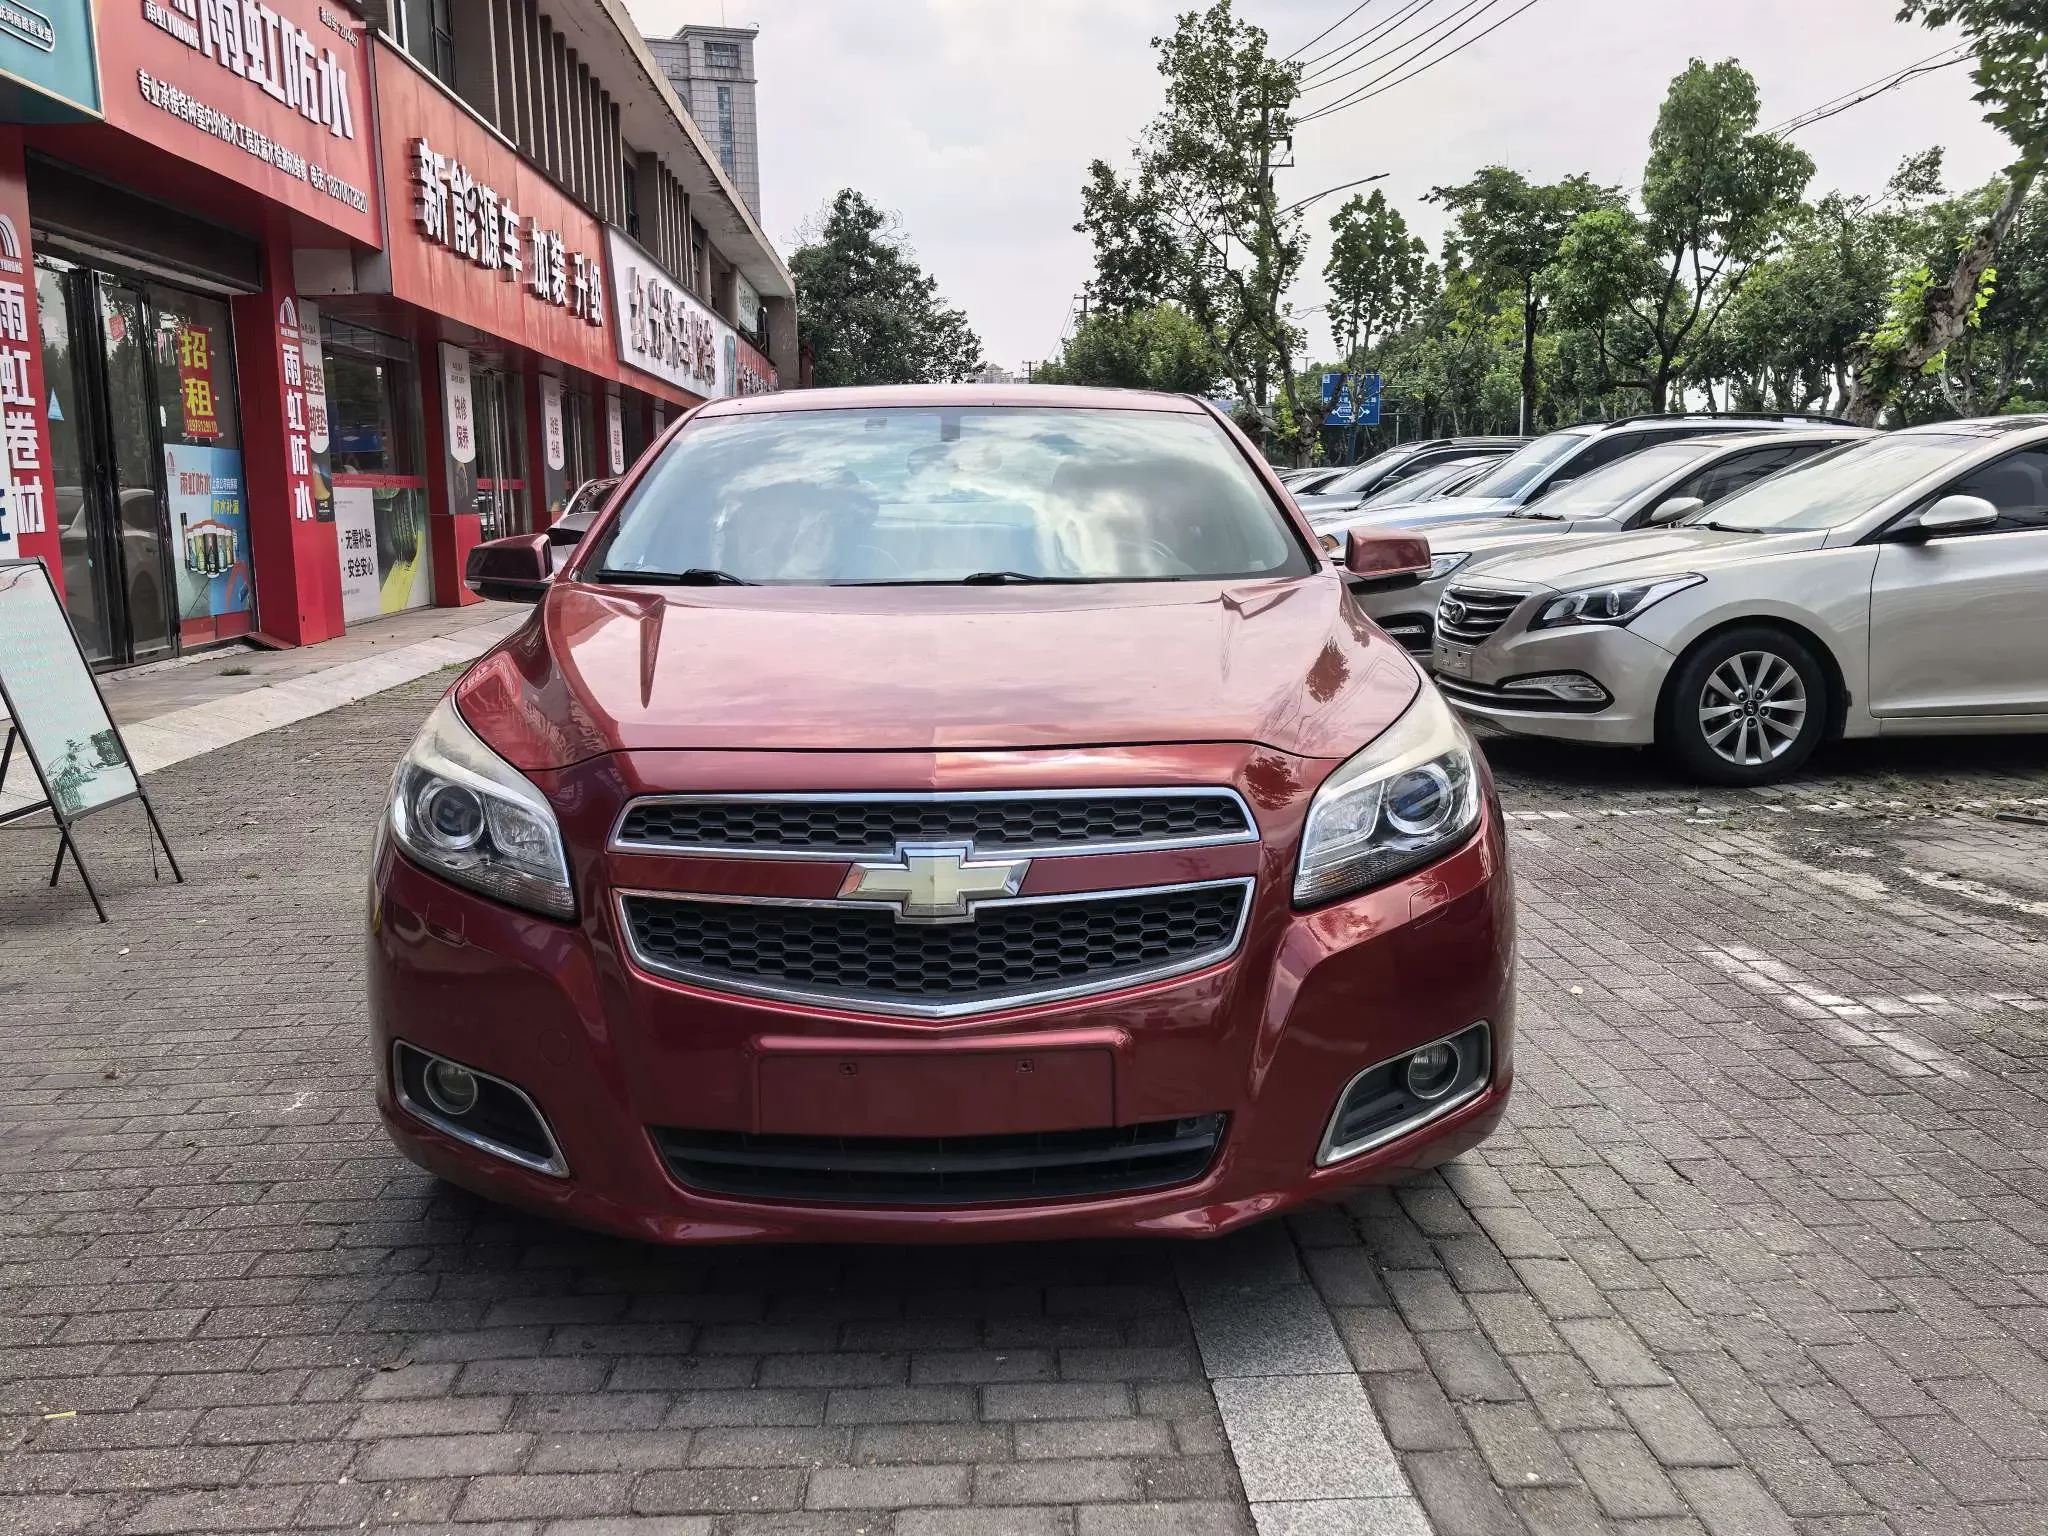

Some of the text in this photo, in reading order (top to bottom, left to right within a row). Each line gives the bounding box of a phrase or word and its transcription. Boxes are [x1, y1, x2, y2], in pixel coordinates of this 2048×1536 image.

[412, 137, 604, 326] 新能源车 加装 升级
[180, 328, 215, 417] 招租
[282, 342, 314, 522] 雨虹防水
[345, 529, 372, 549] 无需补胎
[347, 557, 374, 578] 安全安心
